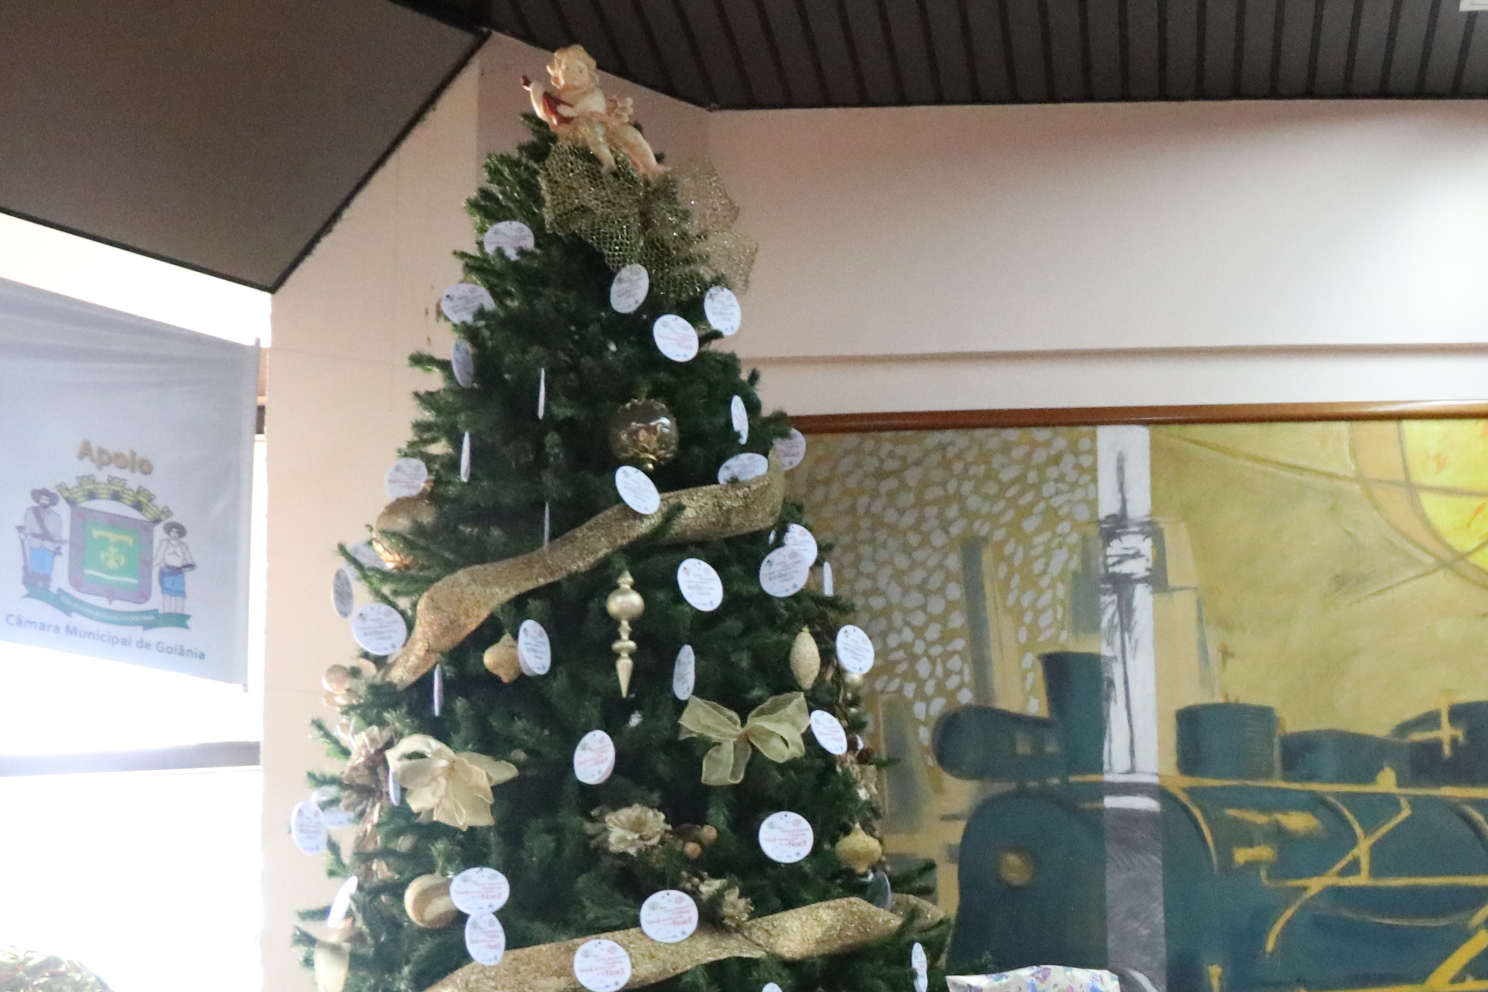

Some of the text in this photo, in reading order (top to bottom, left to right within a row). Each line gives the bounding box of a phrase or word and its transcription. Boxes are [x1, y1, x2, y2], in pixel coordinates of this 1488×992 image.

[77, 439, 154, 476] Apoio
[5, 612, 207, 661] Câmara Municipal de Goiânia
